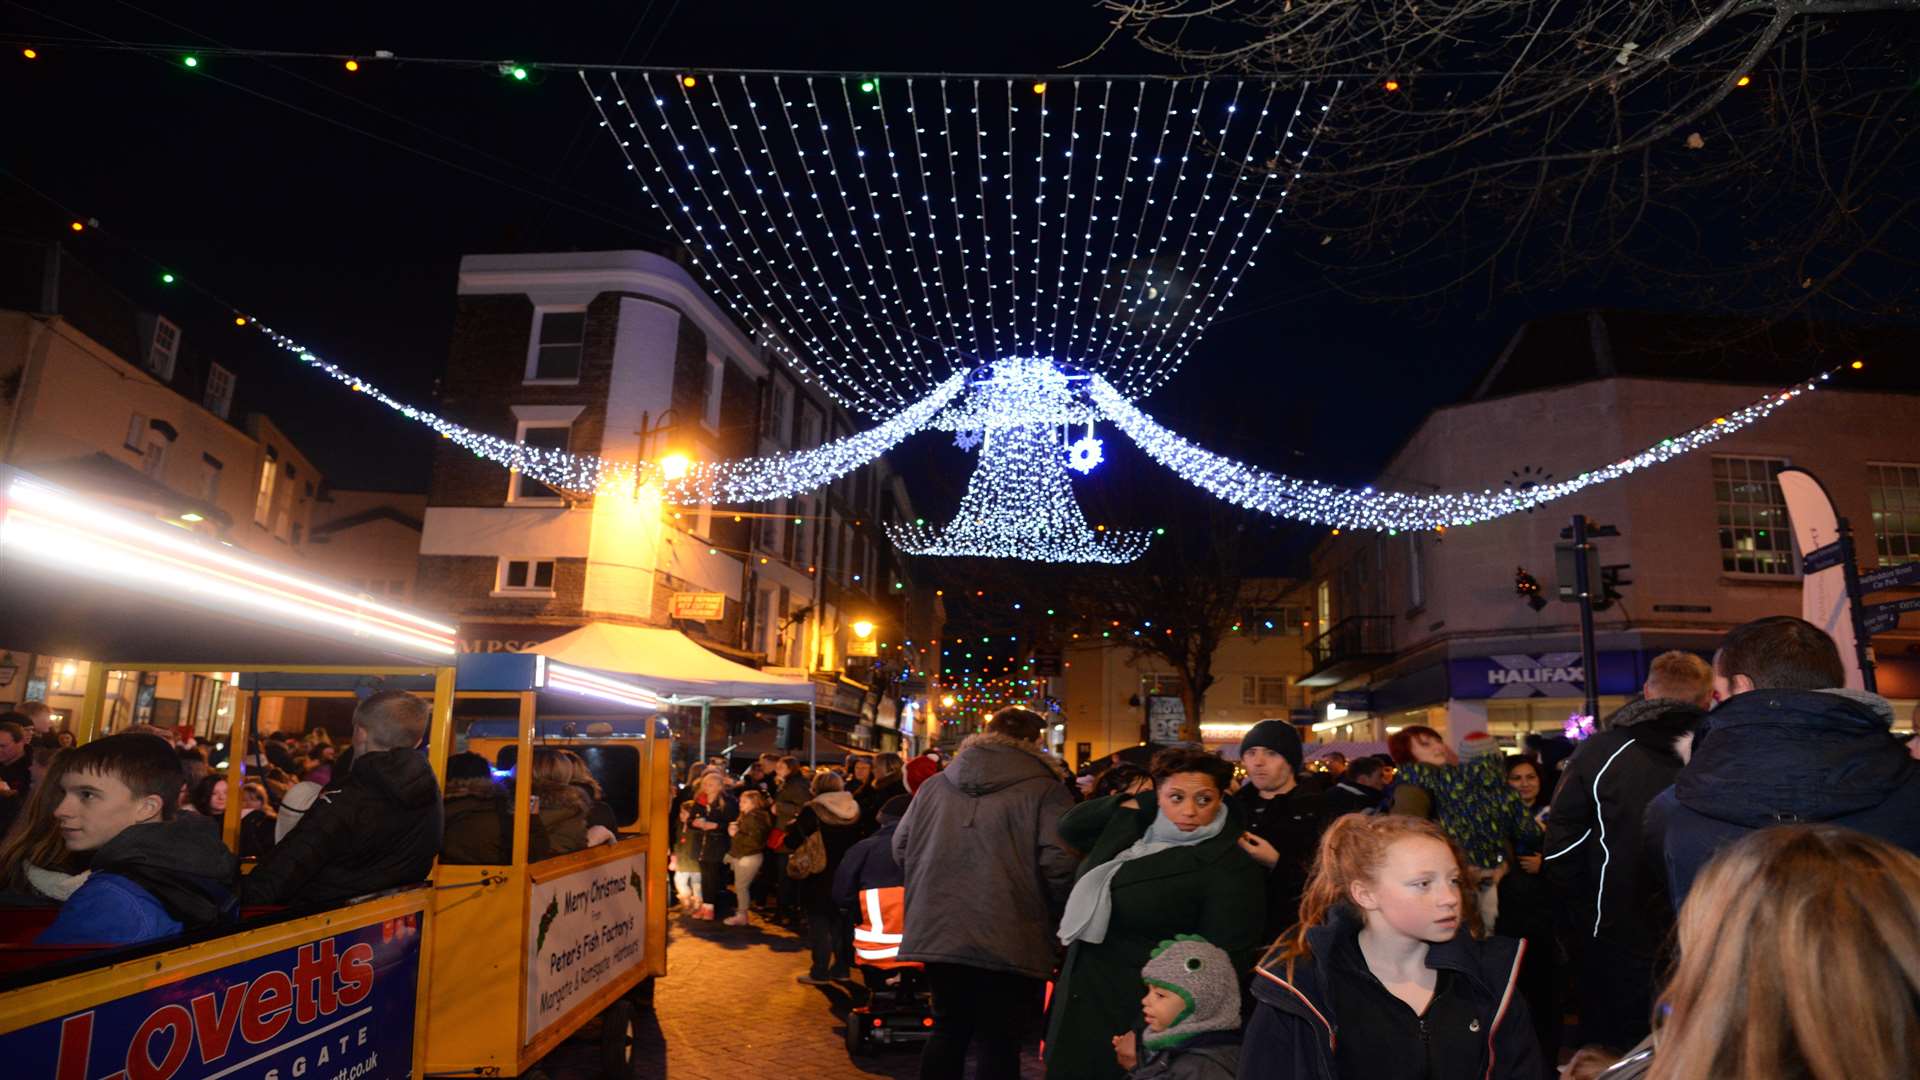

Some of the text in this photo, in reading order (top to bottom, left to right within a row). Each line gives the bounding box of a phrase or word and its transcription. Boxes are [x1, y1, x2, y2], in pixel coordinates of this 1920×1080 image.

[1488, 667, 1585, 684] HALIFAX
[564, 875, 627, 917] Merry Christmas
[551, 939, 583, 976] Peter's
[583, 930, 600, 957] Fish
[540, 982, 573, 1015] Margate
